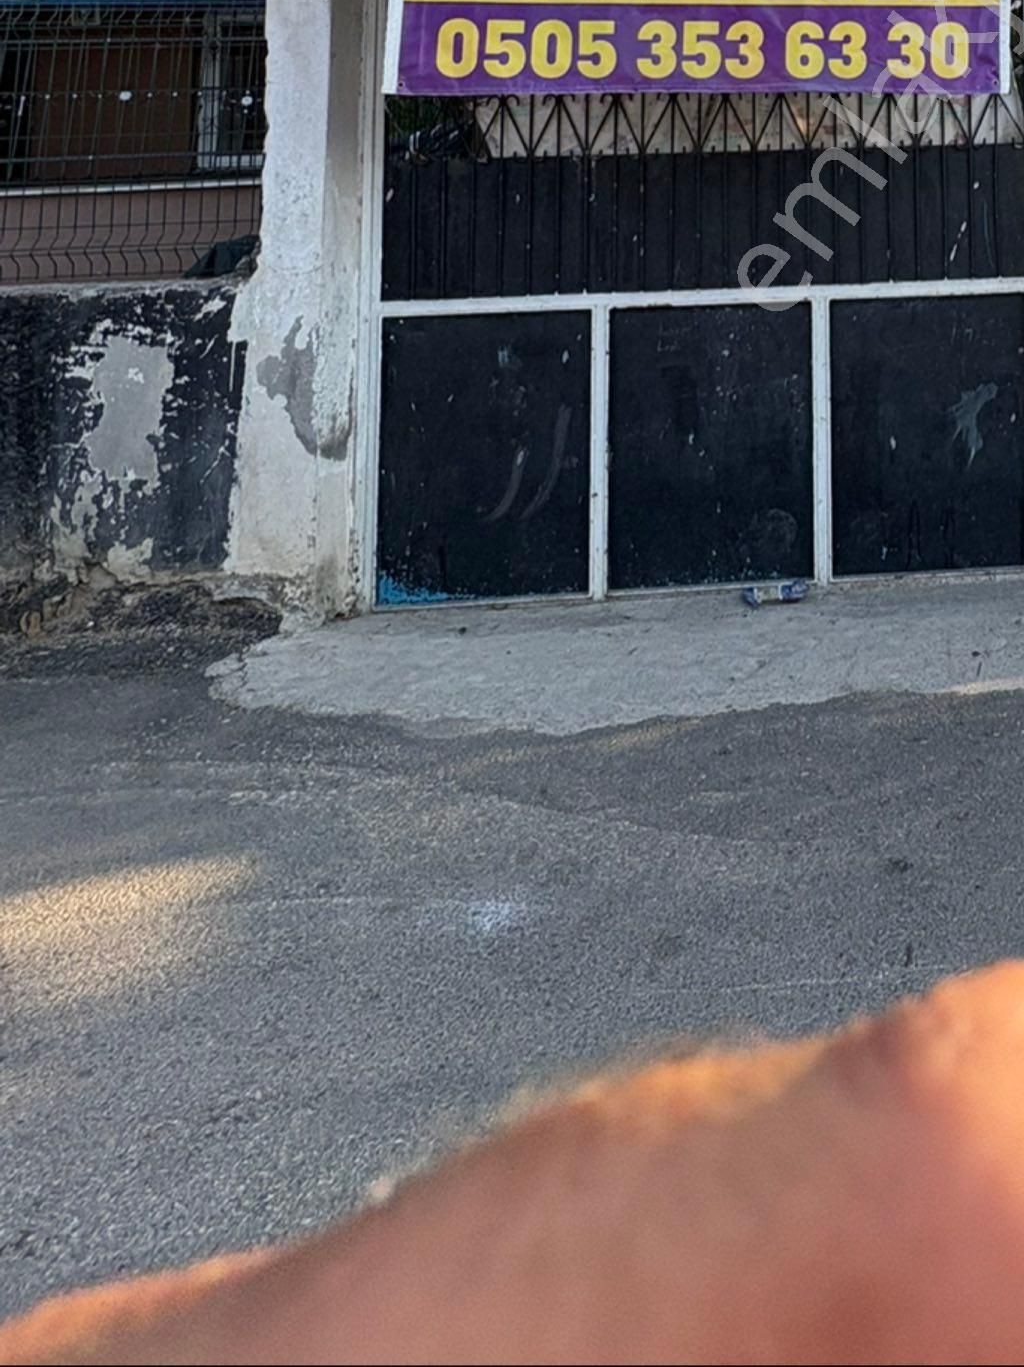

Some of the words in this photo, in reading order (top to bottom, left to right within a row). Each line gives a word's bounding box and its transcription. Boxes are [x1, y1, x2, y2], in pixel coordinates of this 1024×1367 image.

[435, 18, 616, 79] 0505
[636, 20, 765, 80] 353
[784, 21, 868, 80] 63
[886, 22, 970, 80] 30
